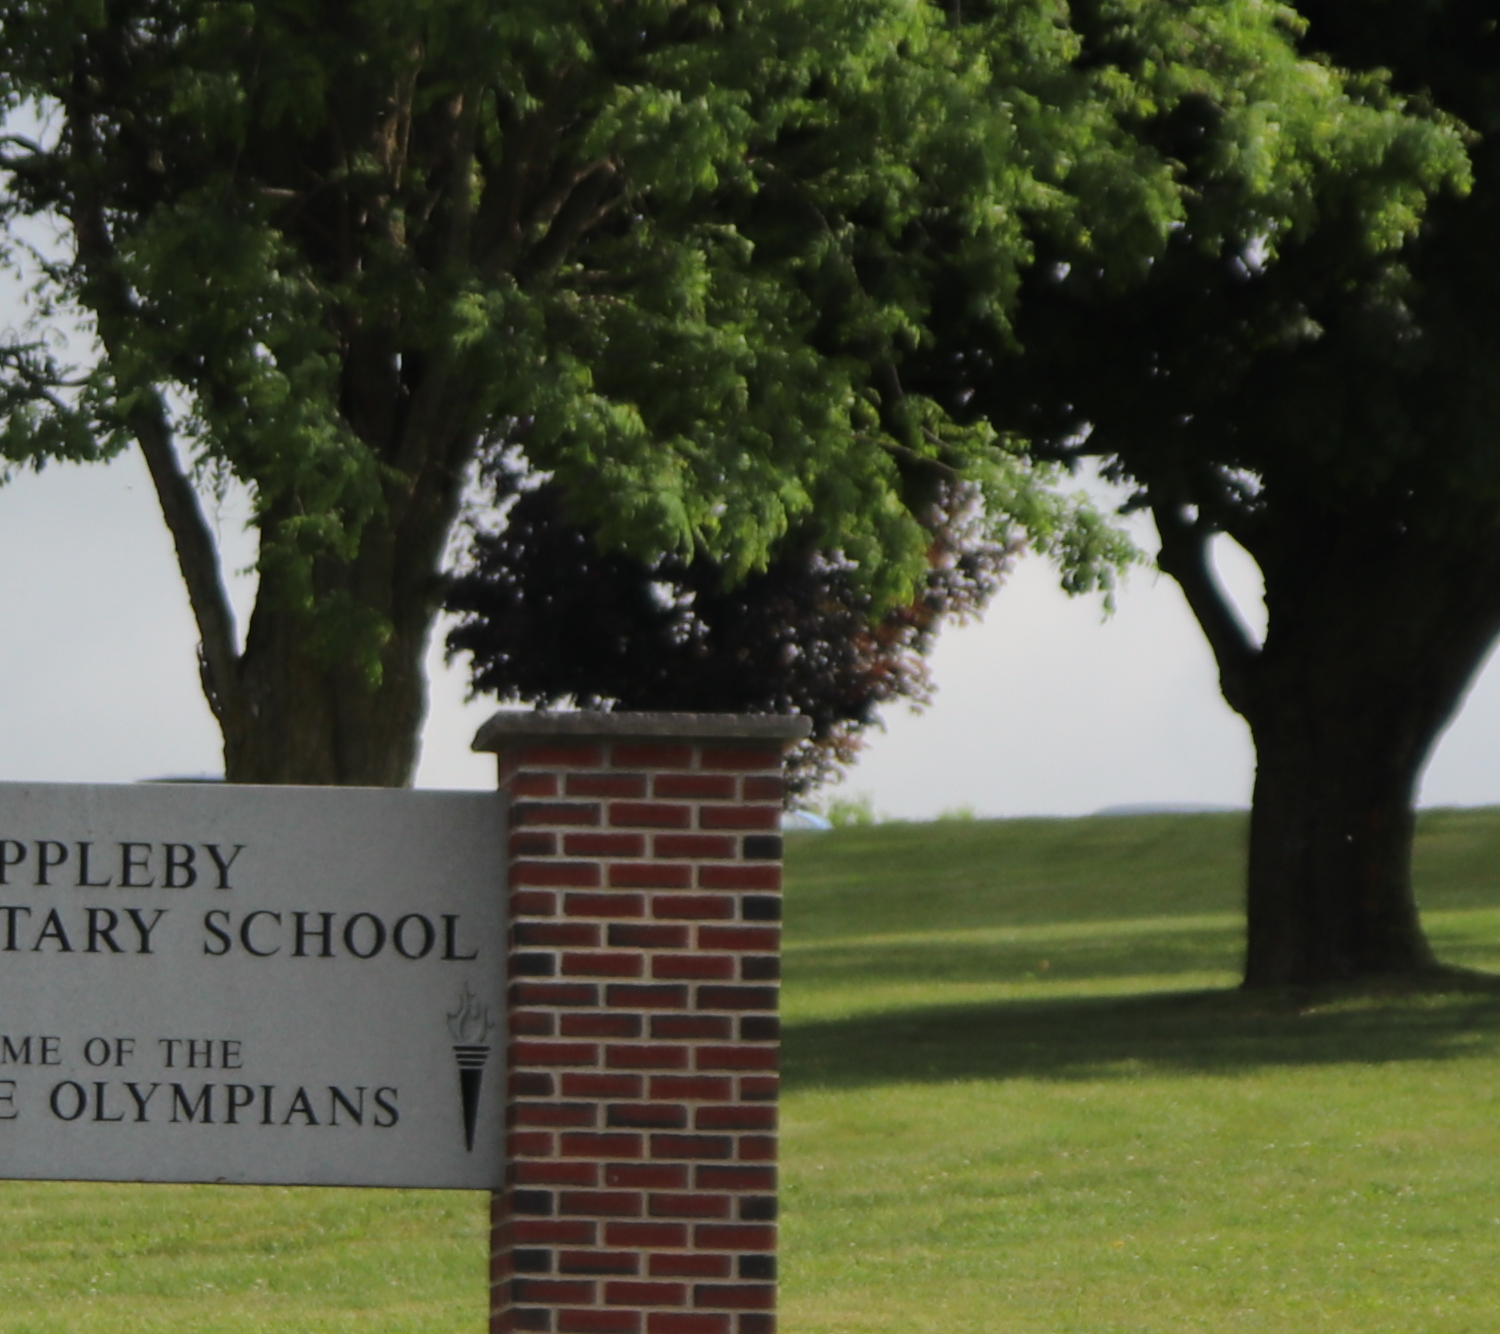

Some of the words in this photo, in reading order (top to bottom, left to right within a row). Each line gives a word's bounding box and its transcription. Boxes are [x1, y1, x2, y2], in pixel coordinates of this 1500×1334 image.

[202, 909, 480, 962] SCHOOL
[83, 1036, 136, 1068] OF
[160, 1038, 243, 1069] THE
[49, 1080, 400, 1128] OLYMPIANS
